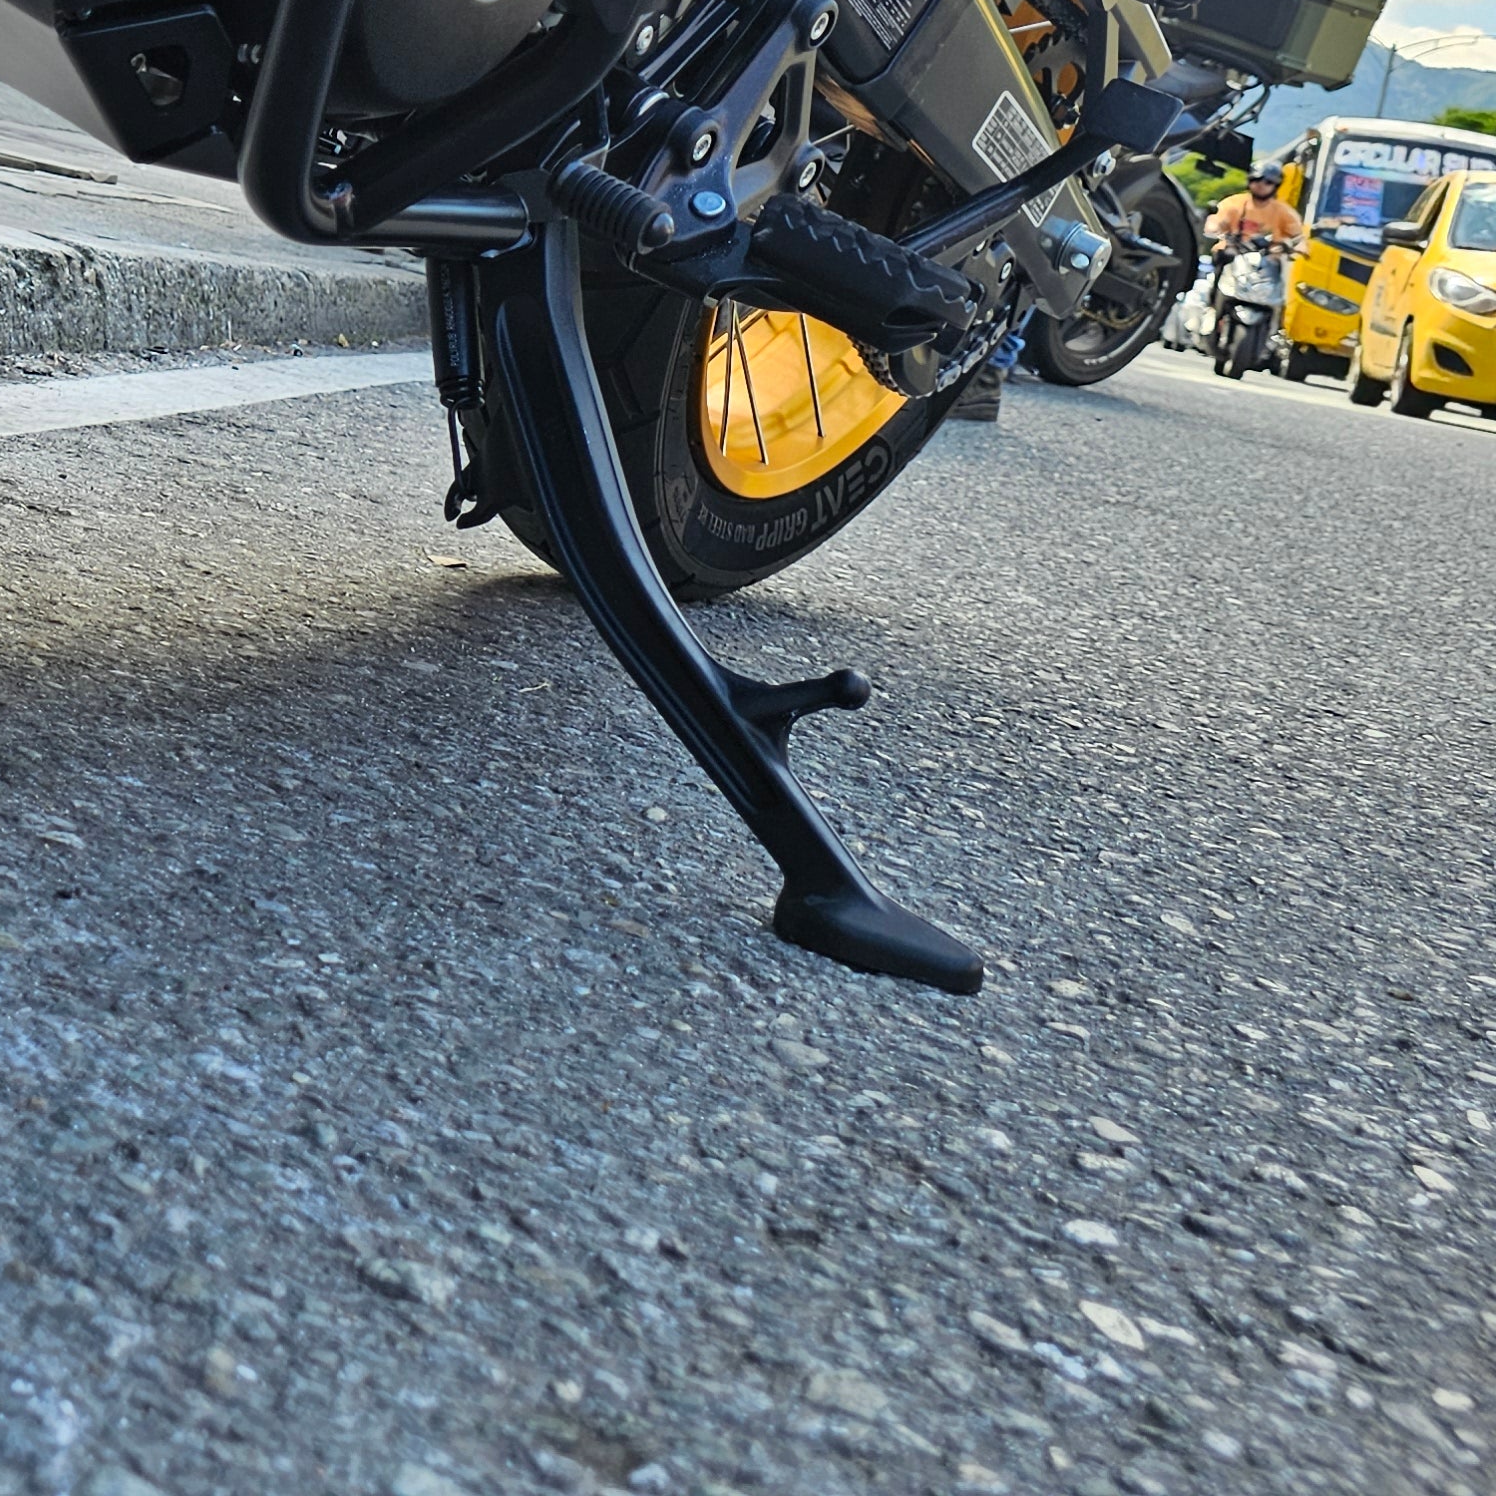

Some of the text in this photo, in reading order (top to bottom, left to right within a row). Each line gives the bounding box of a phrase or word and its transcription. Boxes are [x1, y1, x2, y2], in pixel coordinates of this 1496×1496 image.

[811, 445, 889, 531] CEAT
[707, 512, 734, 542] STEEL
[733, 524, 755, 544] RAD
[755, 508, 808, 551] GRIPP
